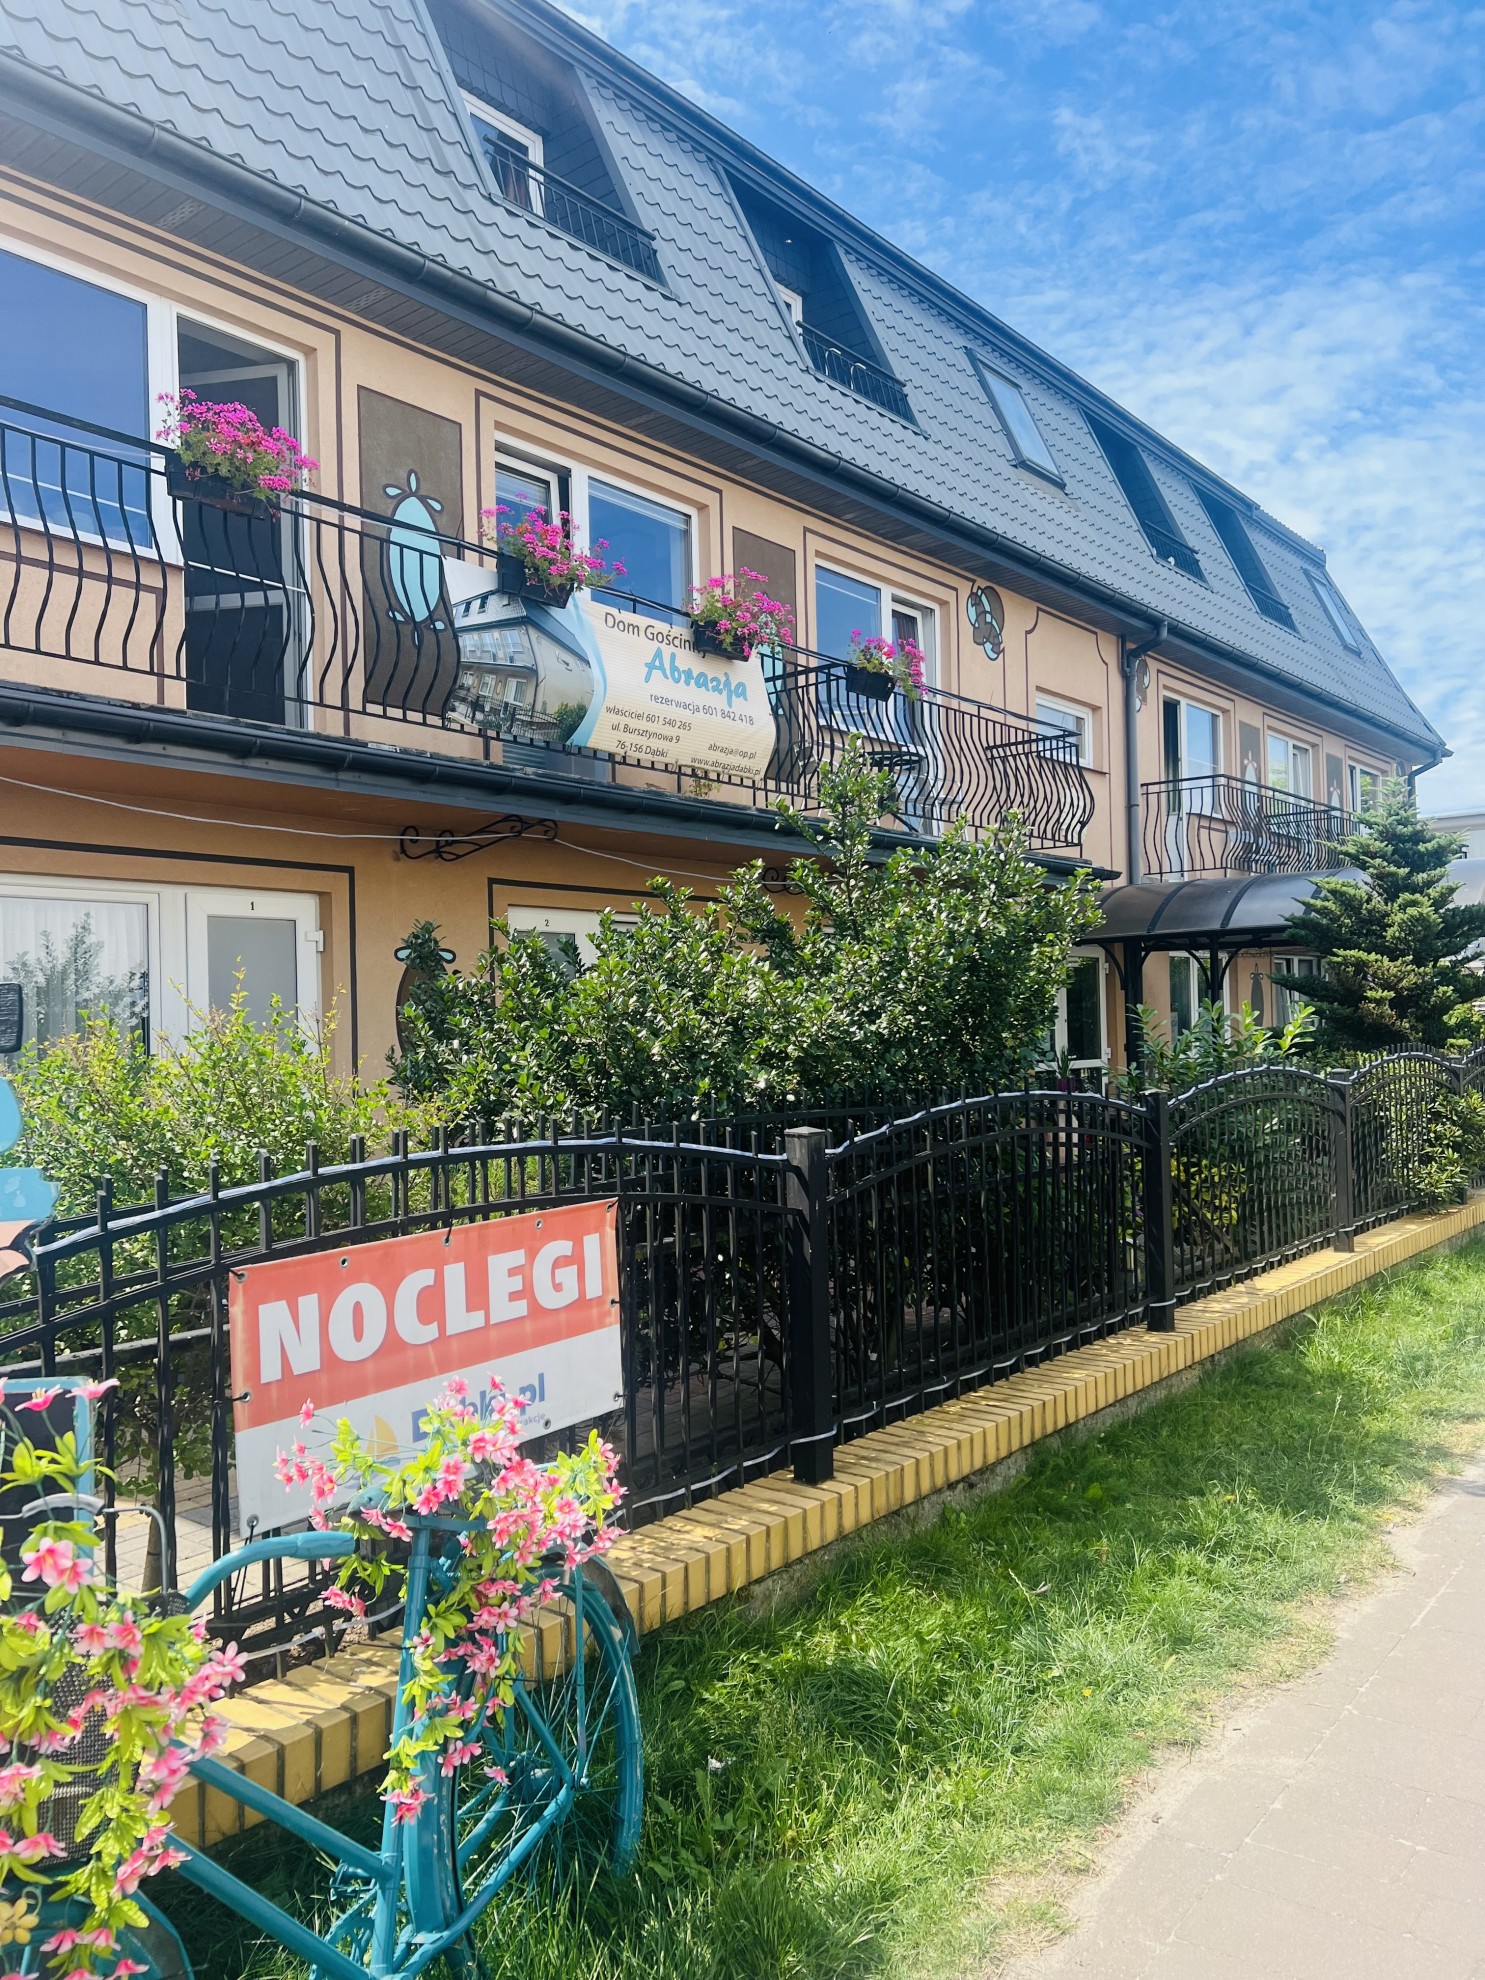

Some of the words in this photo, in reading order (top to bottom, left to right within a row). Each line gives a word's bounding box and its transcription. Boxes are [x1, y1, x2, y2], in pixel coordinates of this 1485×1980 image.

[604, 612, 640, 637] Dom
[644, 624, 705, 657] Gościn
[644, 646, 748, 708] Abrazja
[606, 704, 645, 722] właściciel
[645, 713, 660, 726] 601
[662, 716, 677, 729] 540
[677, 720, 692, 732] 265
[650, 693, 700, 715] rezerwacja
[702, 704, 718, 718] 601
[721, 708, 737, 722] 842
[738, 713, 754, 726] 418
[611, 722, 621, 732] ul.
[623, 723, 674, 743] Bursztynowa
[675, 735, 681, 744] 9
[615, 740, 644, 753] 76-156
[645, 745, 669, 759] Dąbki
[708, 742, 757, 760] abrazja@op.pl
[250, 901, 255, 911] 1
[544, 919, 550, 927] 2
[257, 1232, 604, 1385] NOCLEGI
